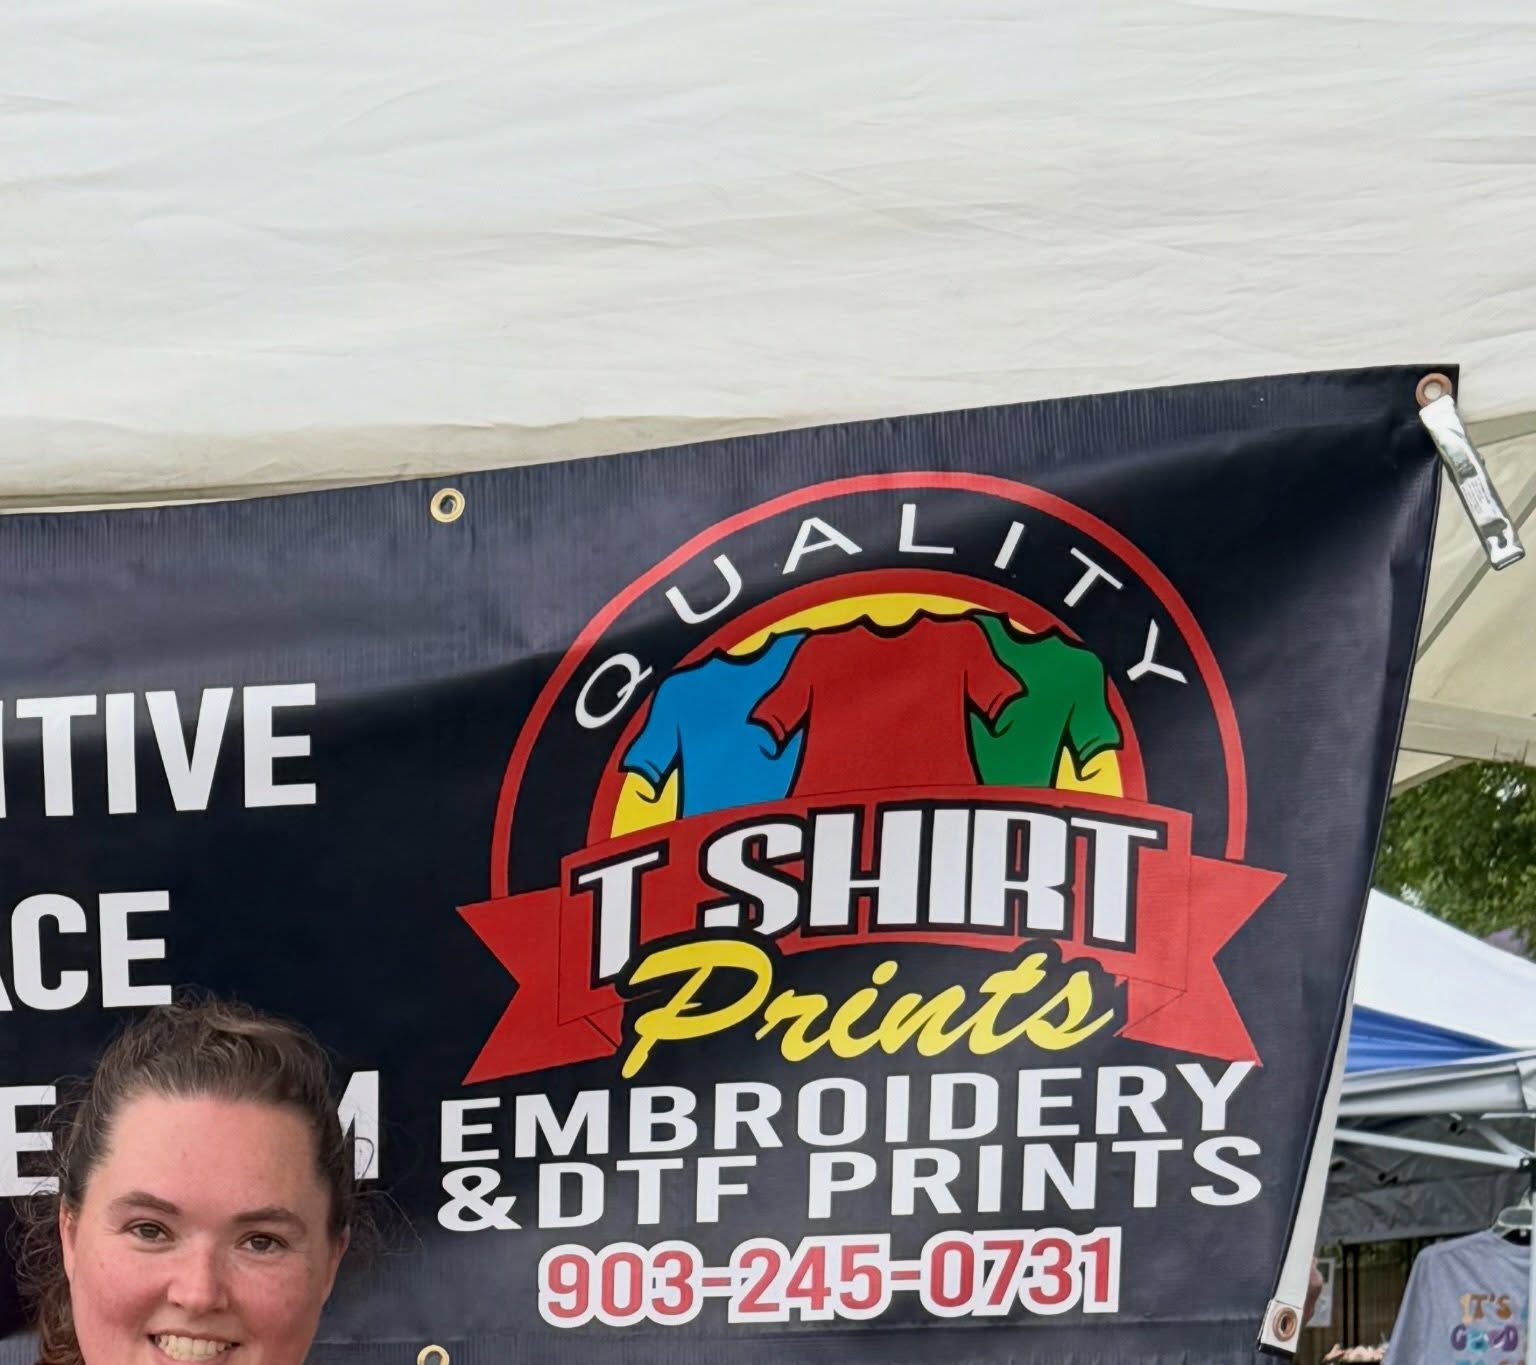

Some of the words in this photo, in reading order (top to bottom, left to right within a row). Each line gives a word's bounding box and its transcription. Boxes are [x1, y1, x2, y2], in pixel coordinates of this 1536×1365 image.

[574, 503, 1188, 731] QUALITY
[577, 850, 665, 980] T
[704, 807, 1160, 945] SHIRT
[622, 938, 1115, 1080] Prints
[439, 1061, 1257, 1163] EMBROIDERY
[807, 1135, 1264, 1221] PRINTS
[540, 1228, 1121, 1327] 903-245-0731
